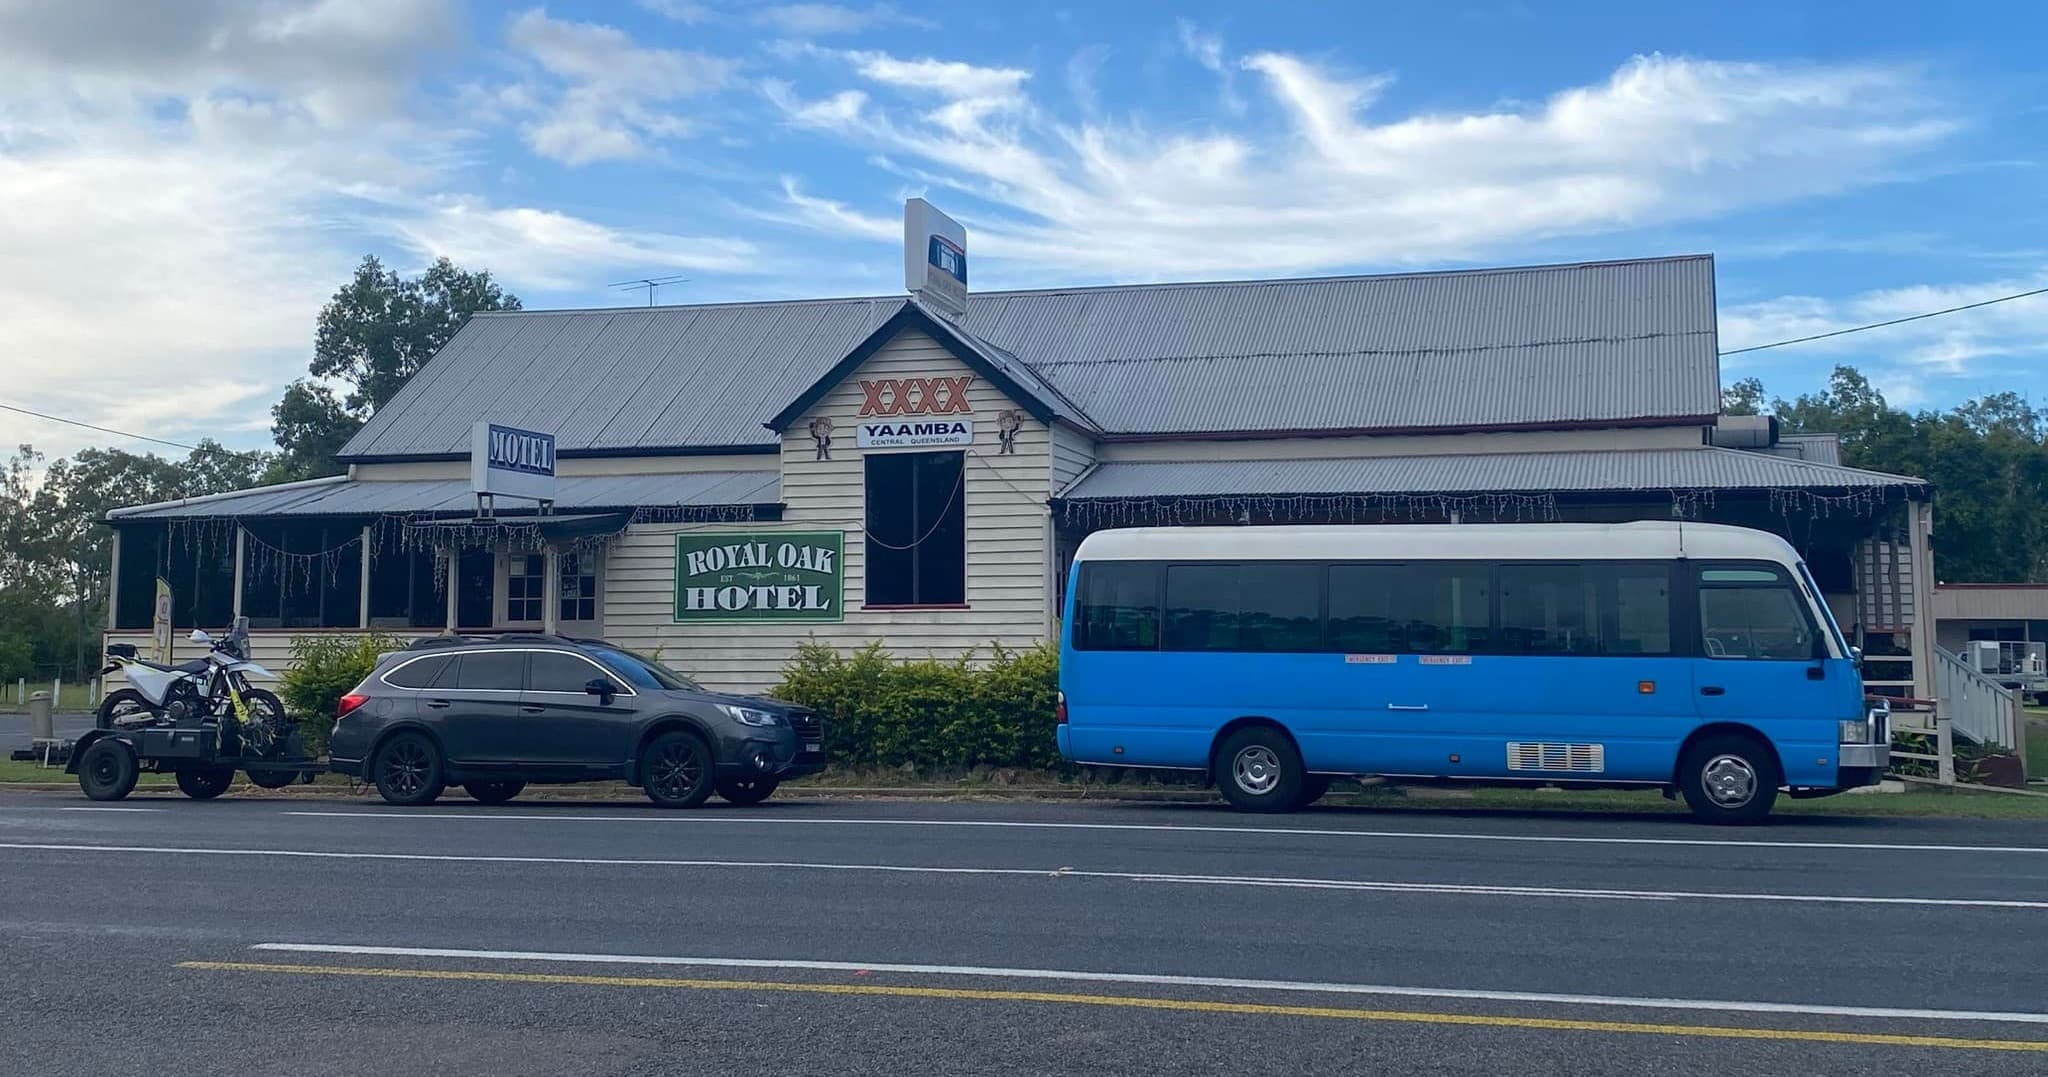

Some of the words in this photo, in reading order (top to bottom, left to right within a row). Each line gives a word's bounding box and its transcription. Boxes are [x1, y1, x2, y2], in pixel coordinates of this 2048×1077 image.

[857, 376, 975, 417] XXXX
[864, 423, 967, 436] YAAMBA
[910, 437, 960, 445] QUEENSLAND
[490, 430, 553, 470] MOTEL
[686, 543, 773, 576] ROYAL
[777, 543, 835, 574] OAK
[720, 574, 734, 583] EST
[685, 584, 831, 611] HOTEL
